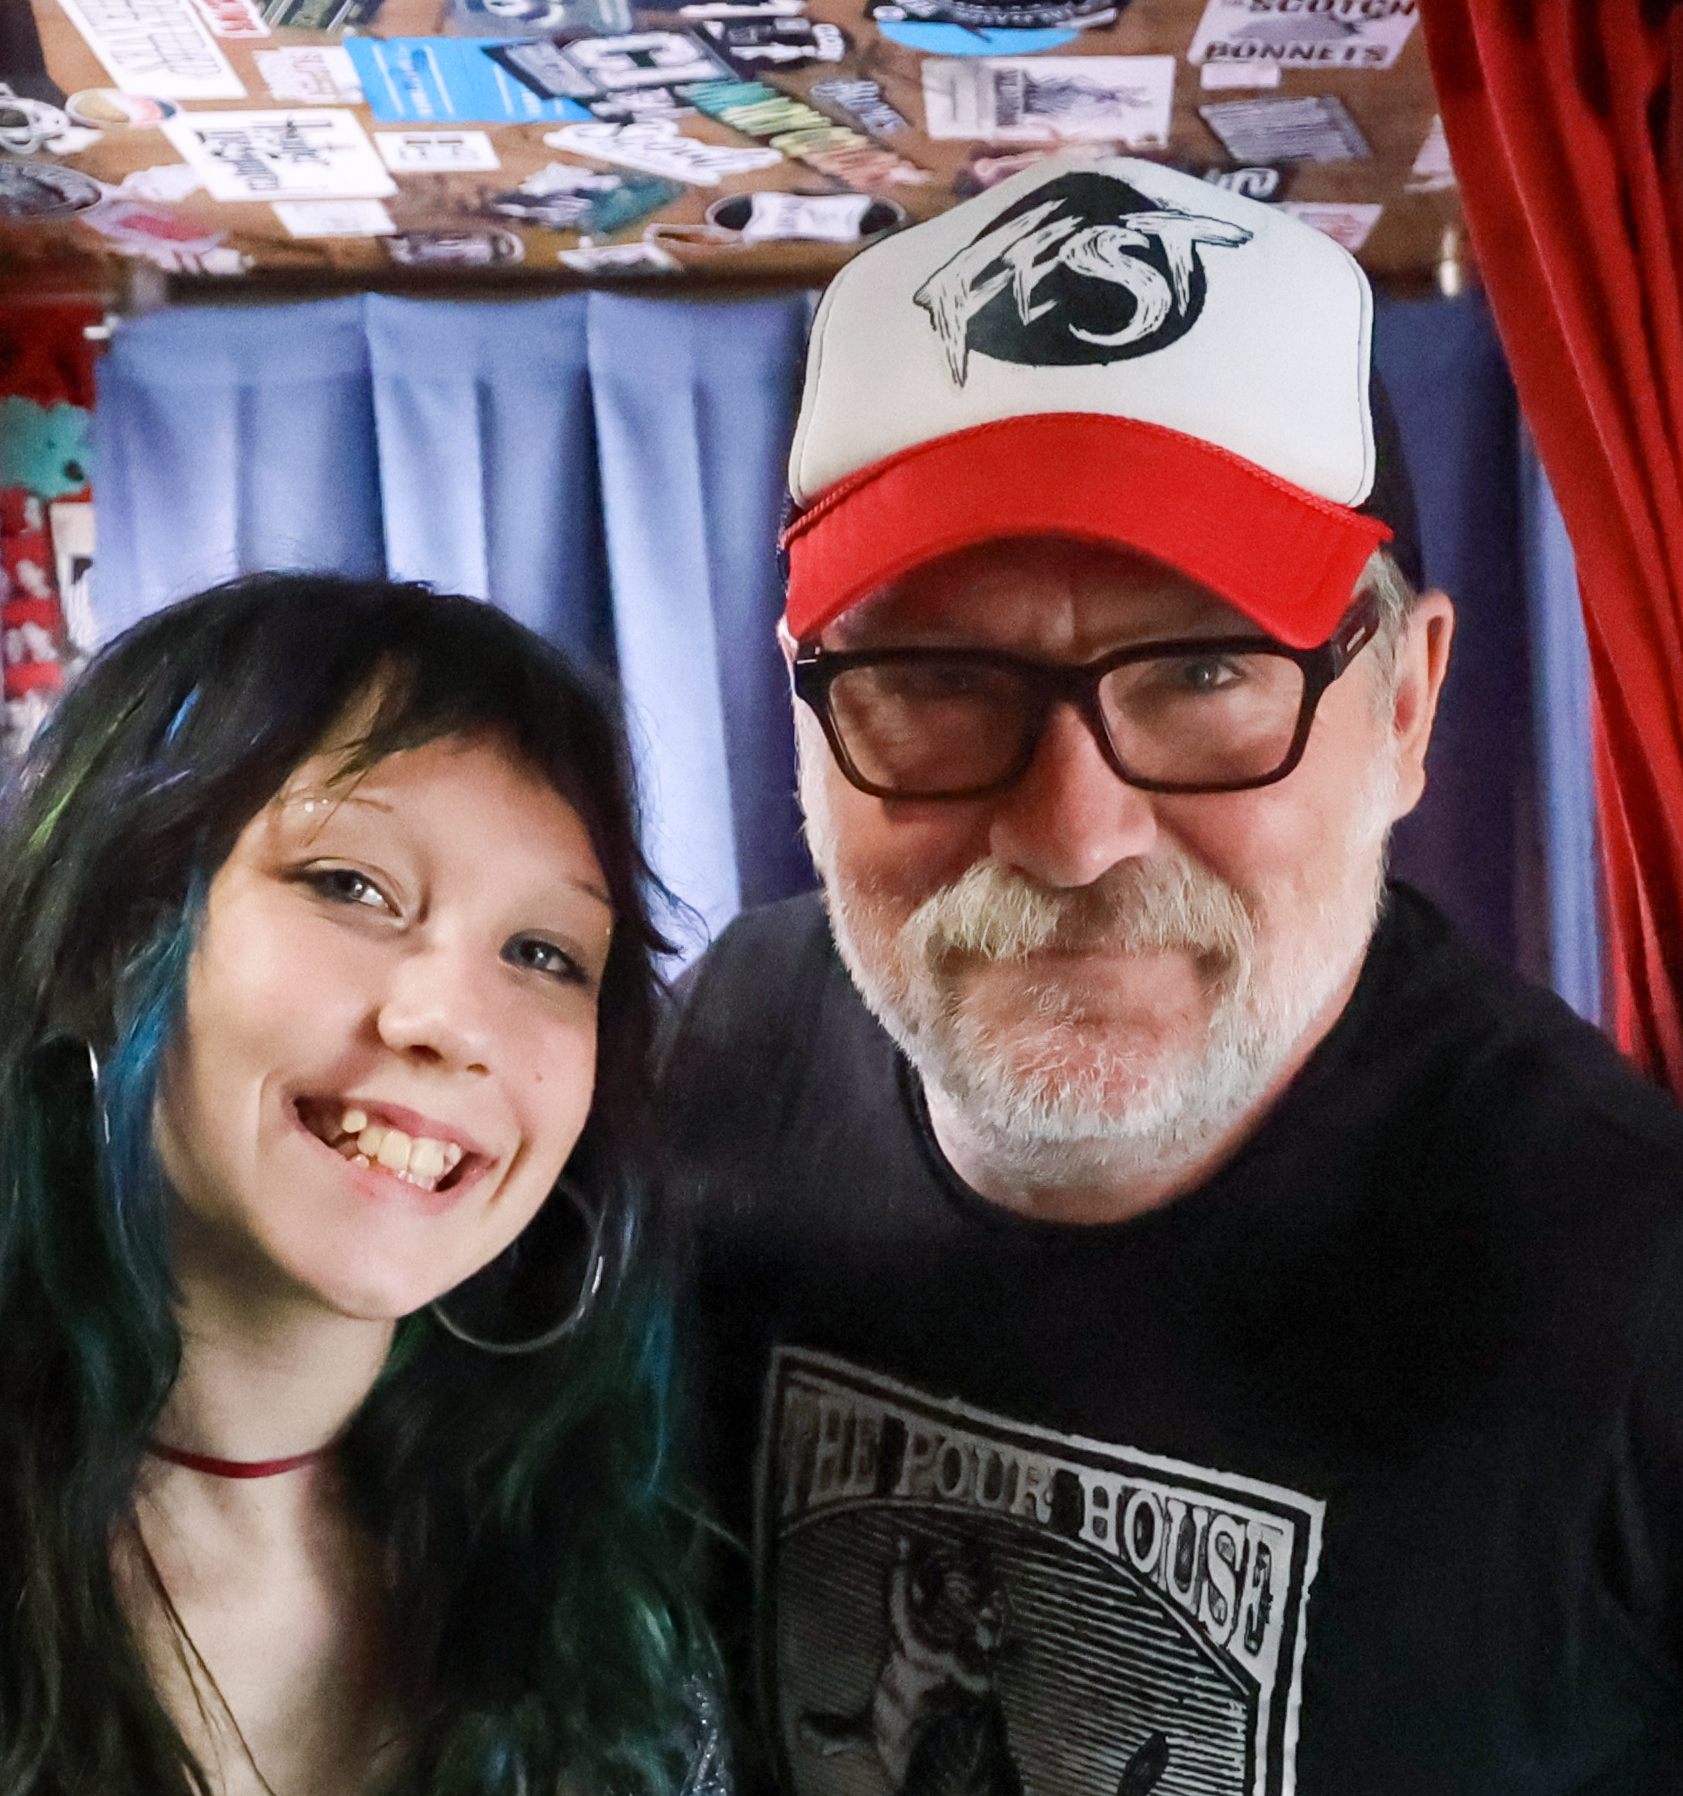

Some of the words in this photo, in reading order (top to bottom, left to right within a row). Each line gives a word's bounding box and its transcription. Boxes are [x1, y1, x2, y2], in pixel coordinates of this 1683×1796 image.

[779, 1389, 880, 1513] THE
[895, 1419, 1055, 1523] POUR
[1076, 1469, 1279, 1657] HOUSE
